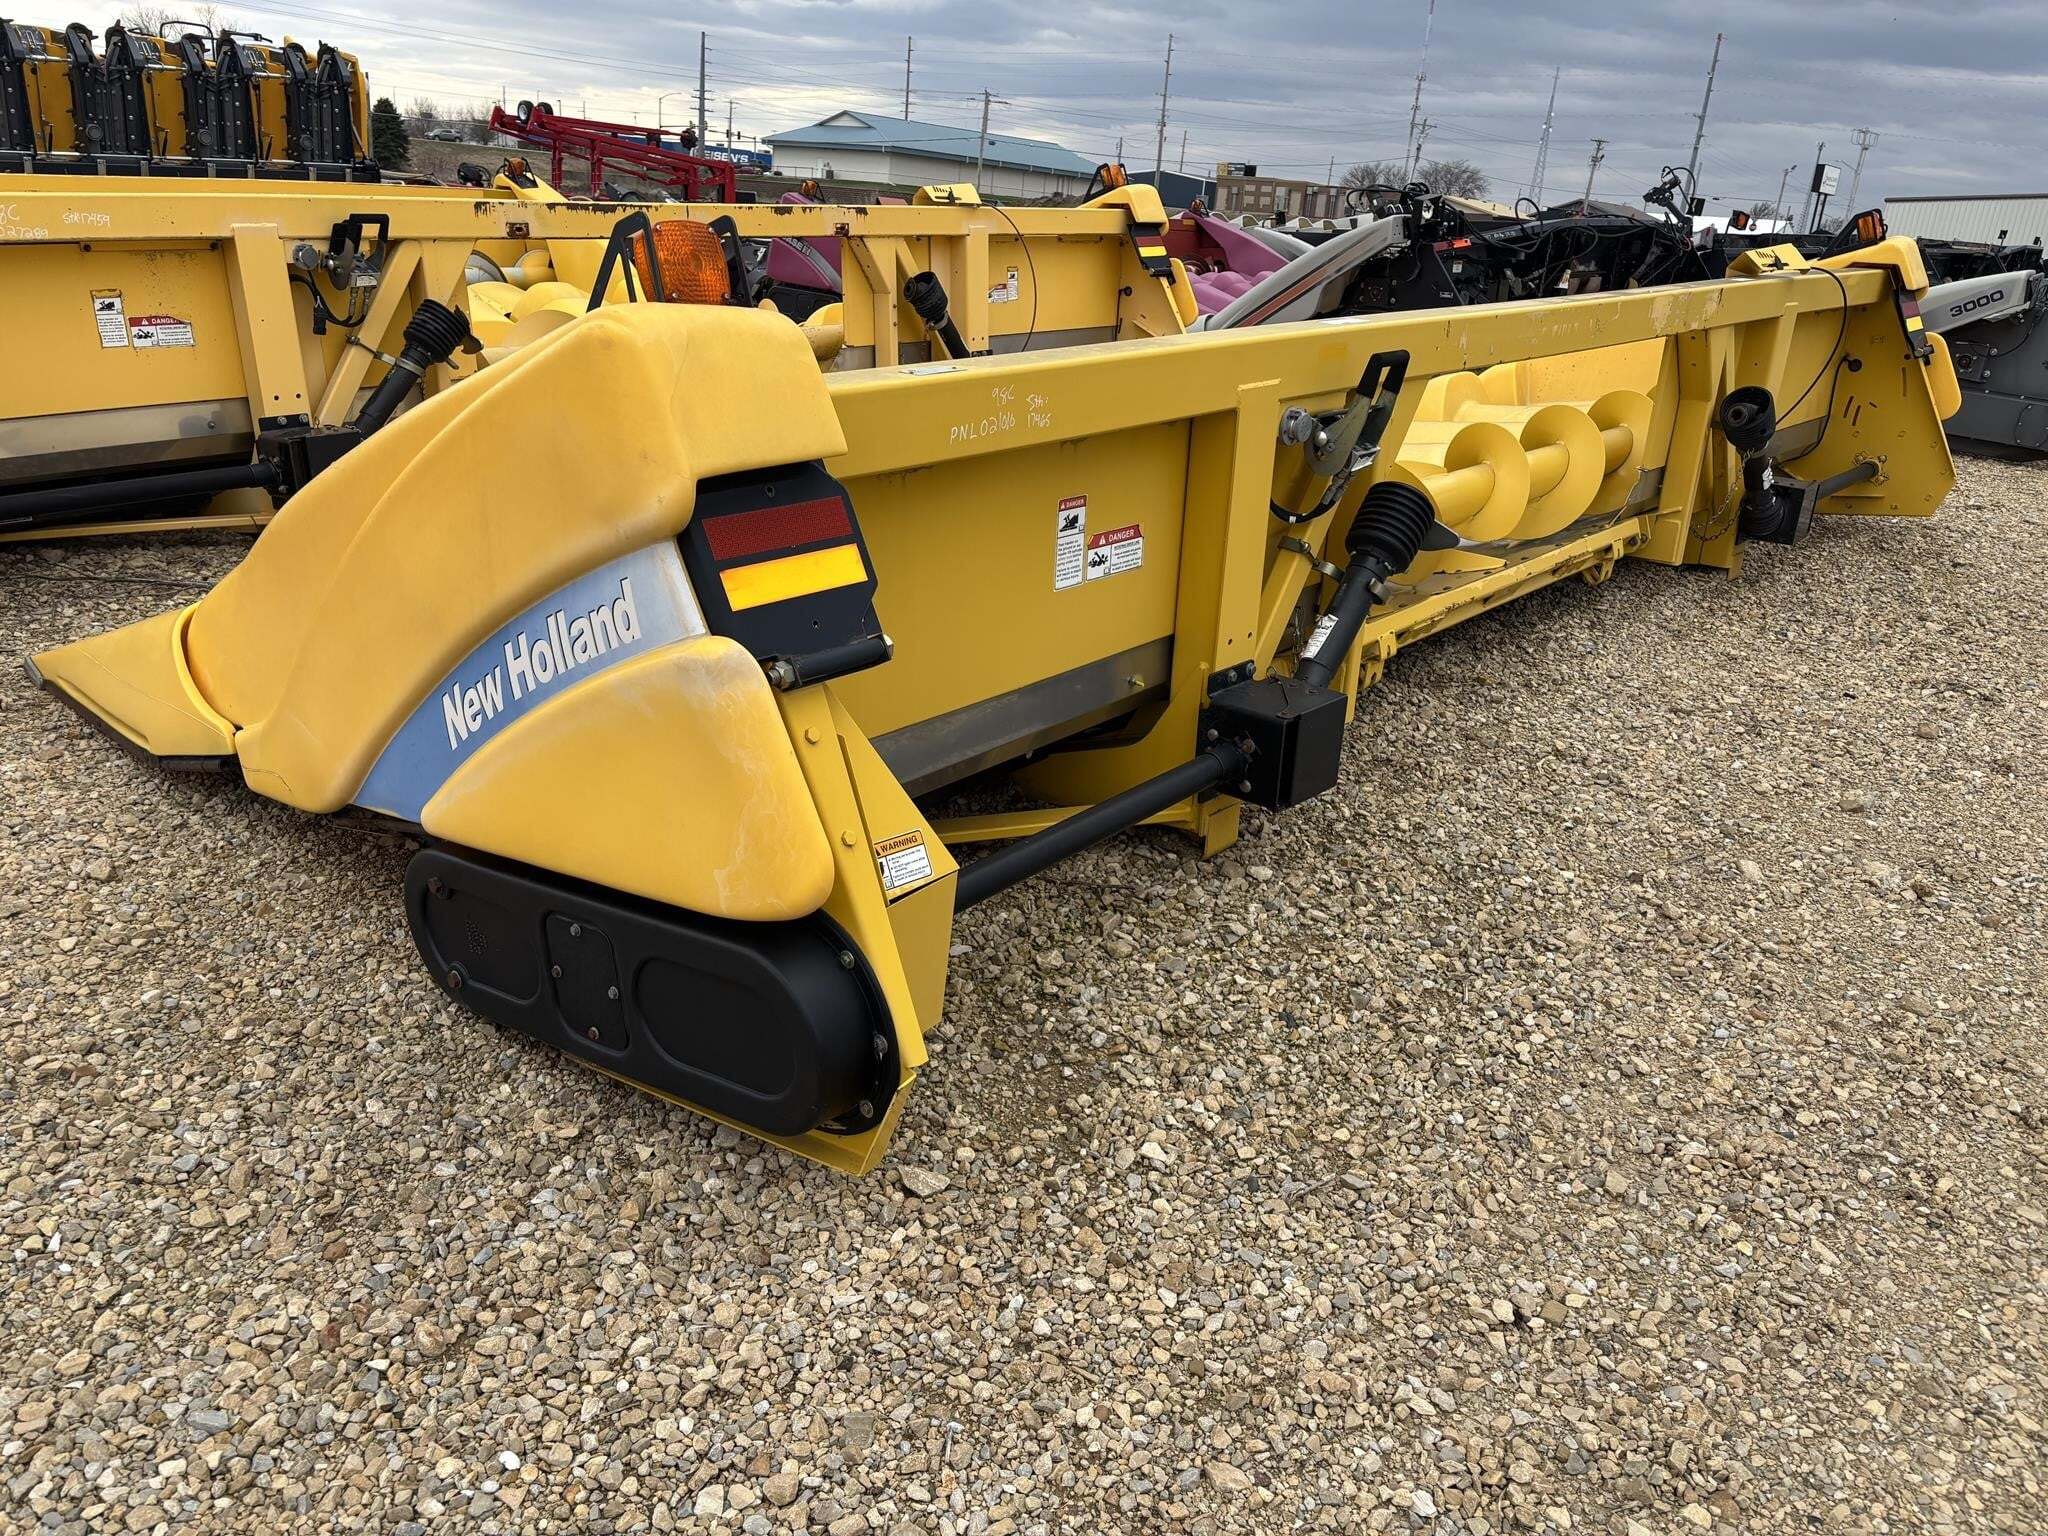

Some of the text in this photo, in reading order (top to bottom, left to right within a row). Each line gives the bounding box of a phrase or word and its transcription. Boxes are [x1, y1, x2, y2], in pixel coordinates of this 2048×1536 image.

[1949, 289, 2005, 318] 3000
[1108, 529, 1135, 543] DANGER
[442, 576, 643, 751] New Holland
[880, 835, 918, 853] WARNING
